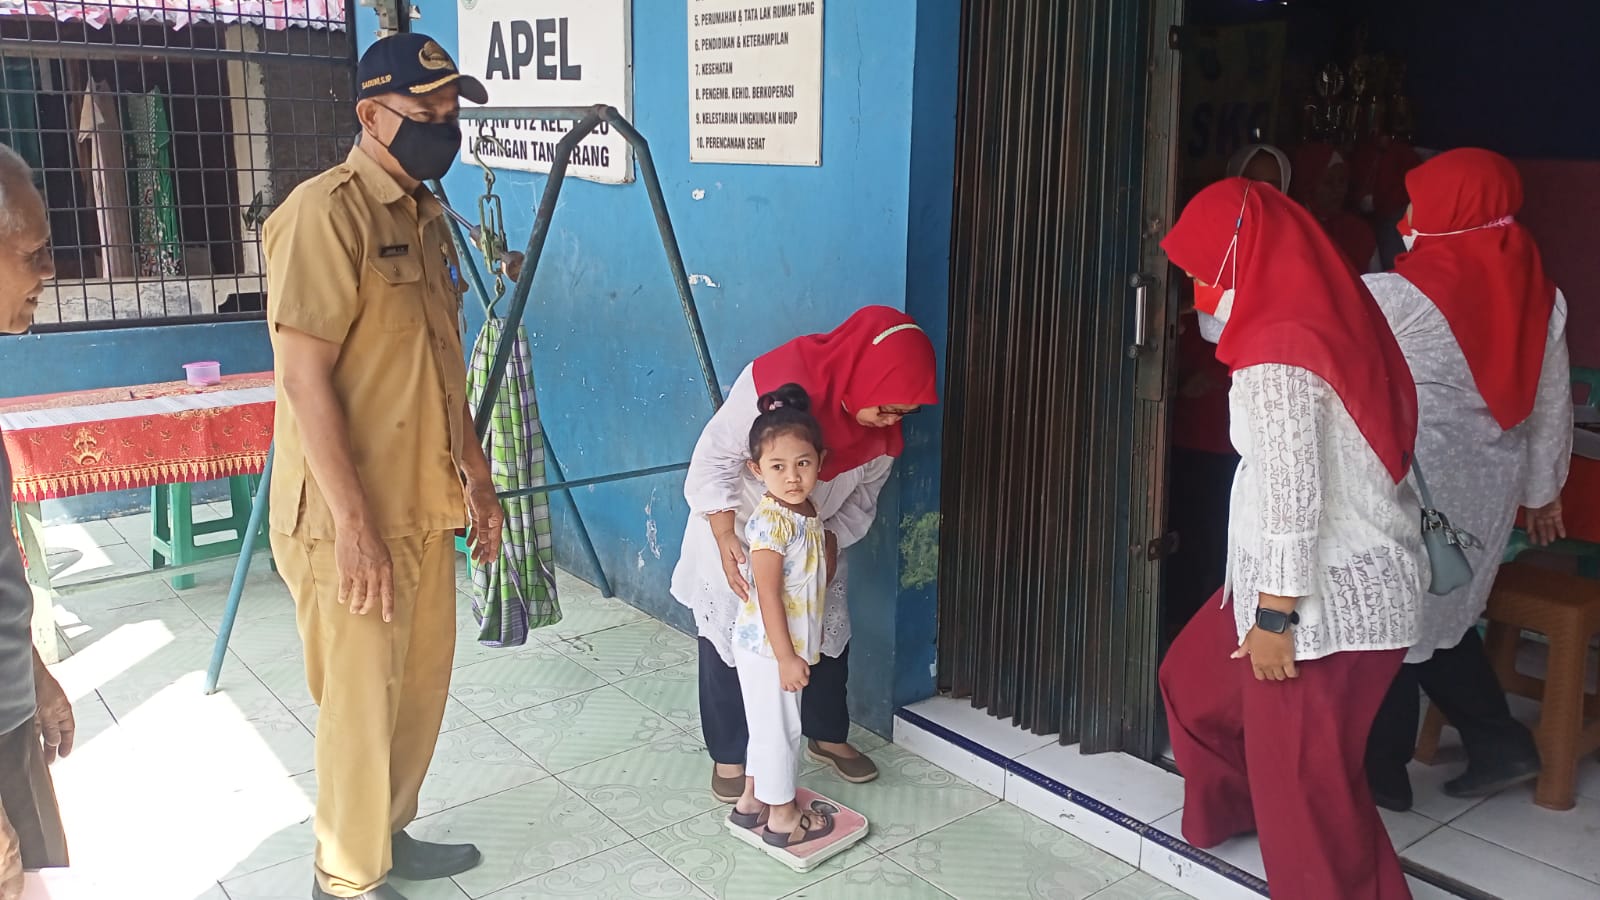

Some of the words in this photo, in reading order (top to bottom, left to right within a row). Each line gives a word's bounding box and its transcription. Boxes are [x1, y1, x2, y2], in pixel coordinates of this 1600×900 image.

[695, 14, 700, 26] 5.
[701, 9, 736, 26] PERUMAHAN
[744, 7, 758, 22] TATA
[759, 6, 771, 20] LAK
[772, 3, 796, 19] RUMAH
[798, 1, 815, 16] TANG
[486, 17, 582, 81] APEL
[695, 39, 700, 51] 6.
[701, 35, 735, 51] PENDIDIKAN
[736, 35, 741, 48] &
[742, 31, 789, 48] KETERAMPILAN
[695, 64, 700, 76] 7.
[701, 62, 733, 76] KESEHATAN
[696, 88, 701, 100] 8.
[702, 87, 730, 100] PENGEMB.
[731, 86, 750, 99] KEHID.
[752, 84, 794, 99] BERKOPERASI
[696, 112, 701, 125] 9.
[702, 112, 738, 125] KELESTARIAN
[739, 111, 777, 125] LINGKUNGAN
[778, 111, 798, 125] HIDUP
[696, 136, 704, 149] 10.
[705, 136, 745, 149] PERENCANAAN
[747, 137, 766, 150] SEHAT
[531, 141, 609, 167] TANRANG
